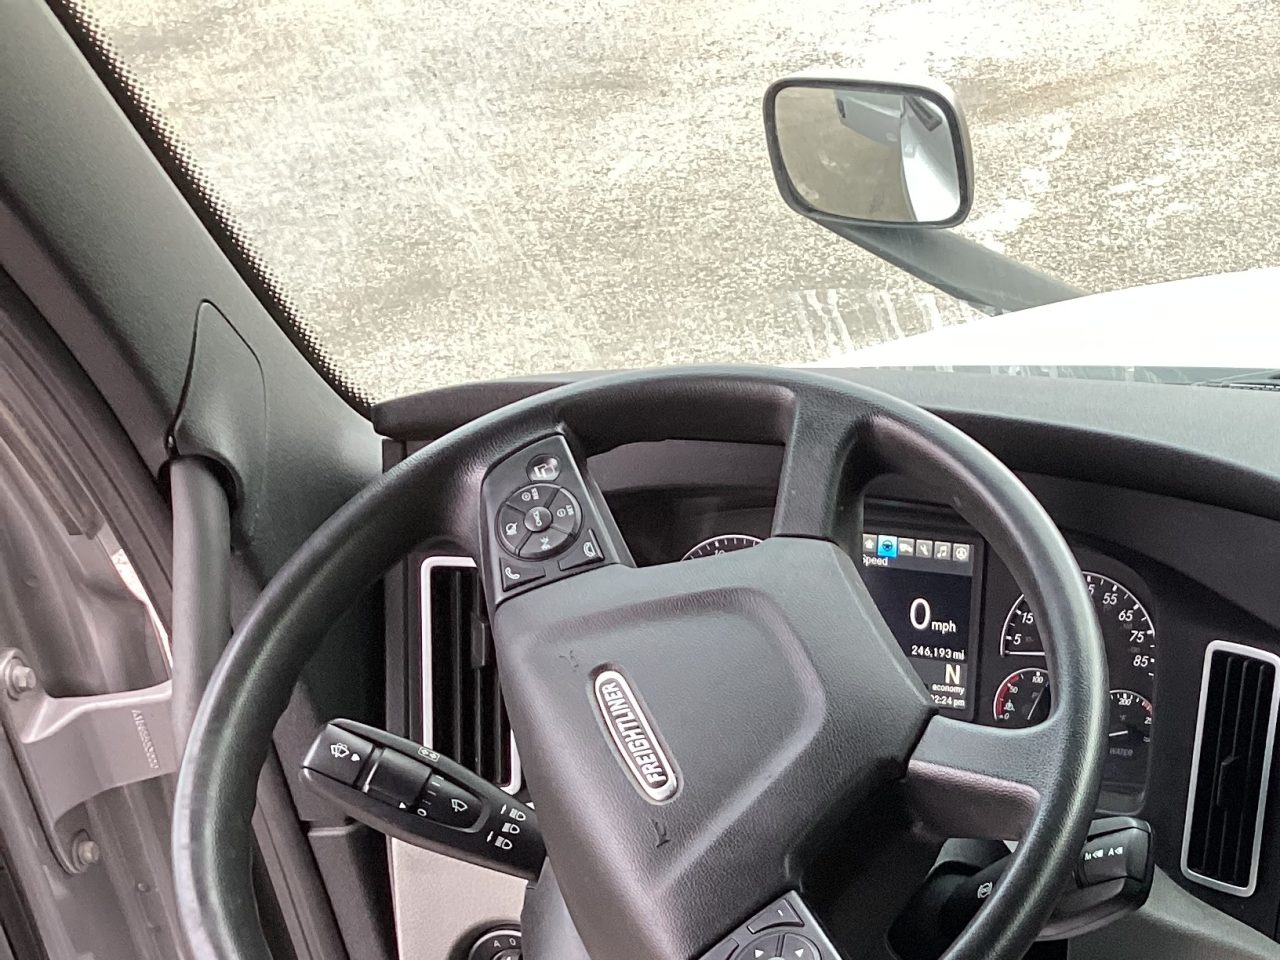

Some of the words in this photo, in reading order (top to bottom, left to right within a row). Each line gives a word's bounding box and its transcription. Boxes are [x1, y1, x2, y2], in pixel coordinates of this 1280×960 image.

[862, 554, 888, 567] Speed
[1102, 592, 1118, 605] 55
[909, 598, 931, 630] 0
[931, 620, 957, 634] mph
[1021, 612, 1034, 624] 15
[1118, 609, 1133, 622] 65
[1013, 634, 1022, 645] 5
[1129, 630, 1145, 643] 75
[953, 649, 965, 660] mi
[1133, 655, 1149, 667] 85
[945, 663, 960, 685] N
[1031, 676, 1044, 684] 100
[932, 684, 965, 696] economy
[1009, 686, 1018, 694] 50
[930, 694, 952, 705] 2:24
[953, 699, 965, 708] pm
[1118, 698, 1131, 706] 200
[600, 681, 667, 784] FREIGHTLINER
[493, 939, 502, 948] A
